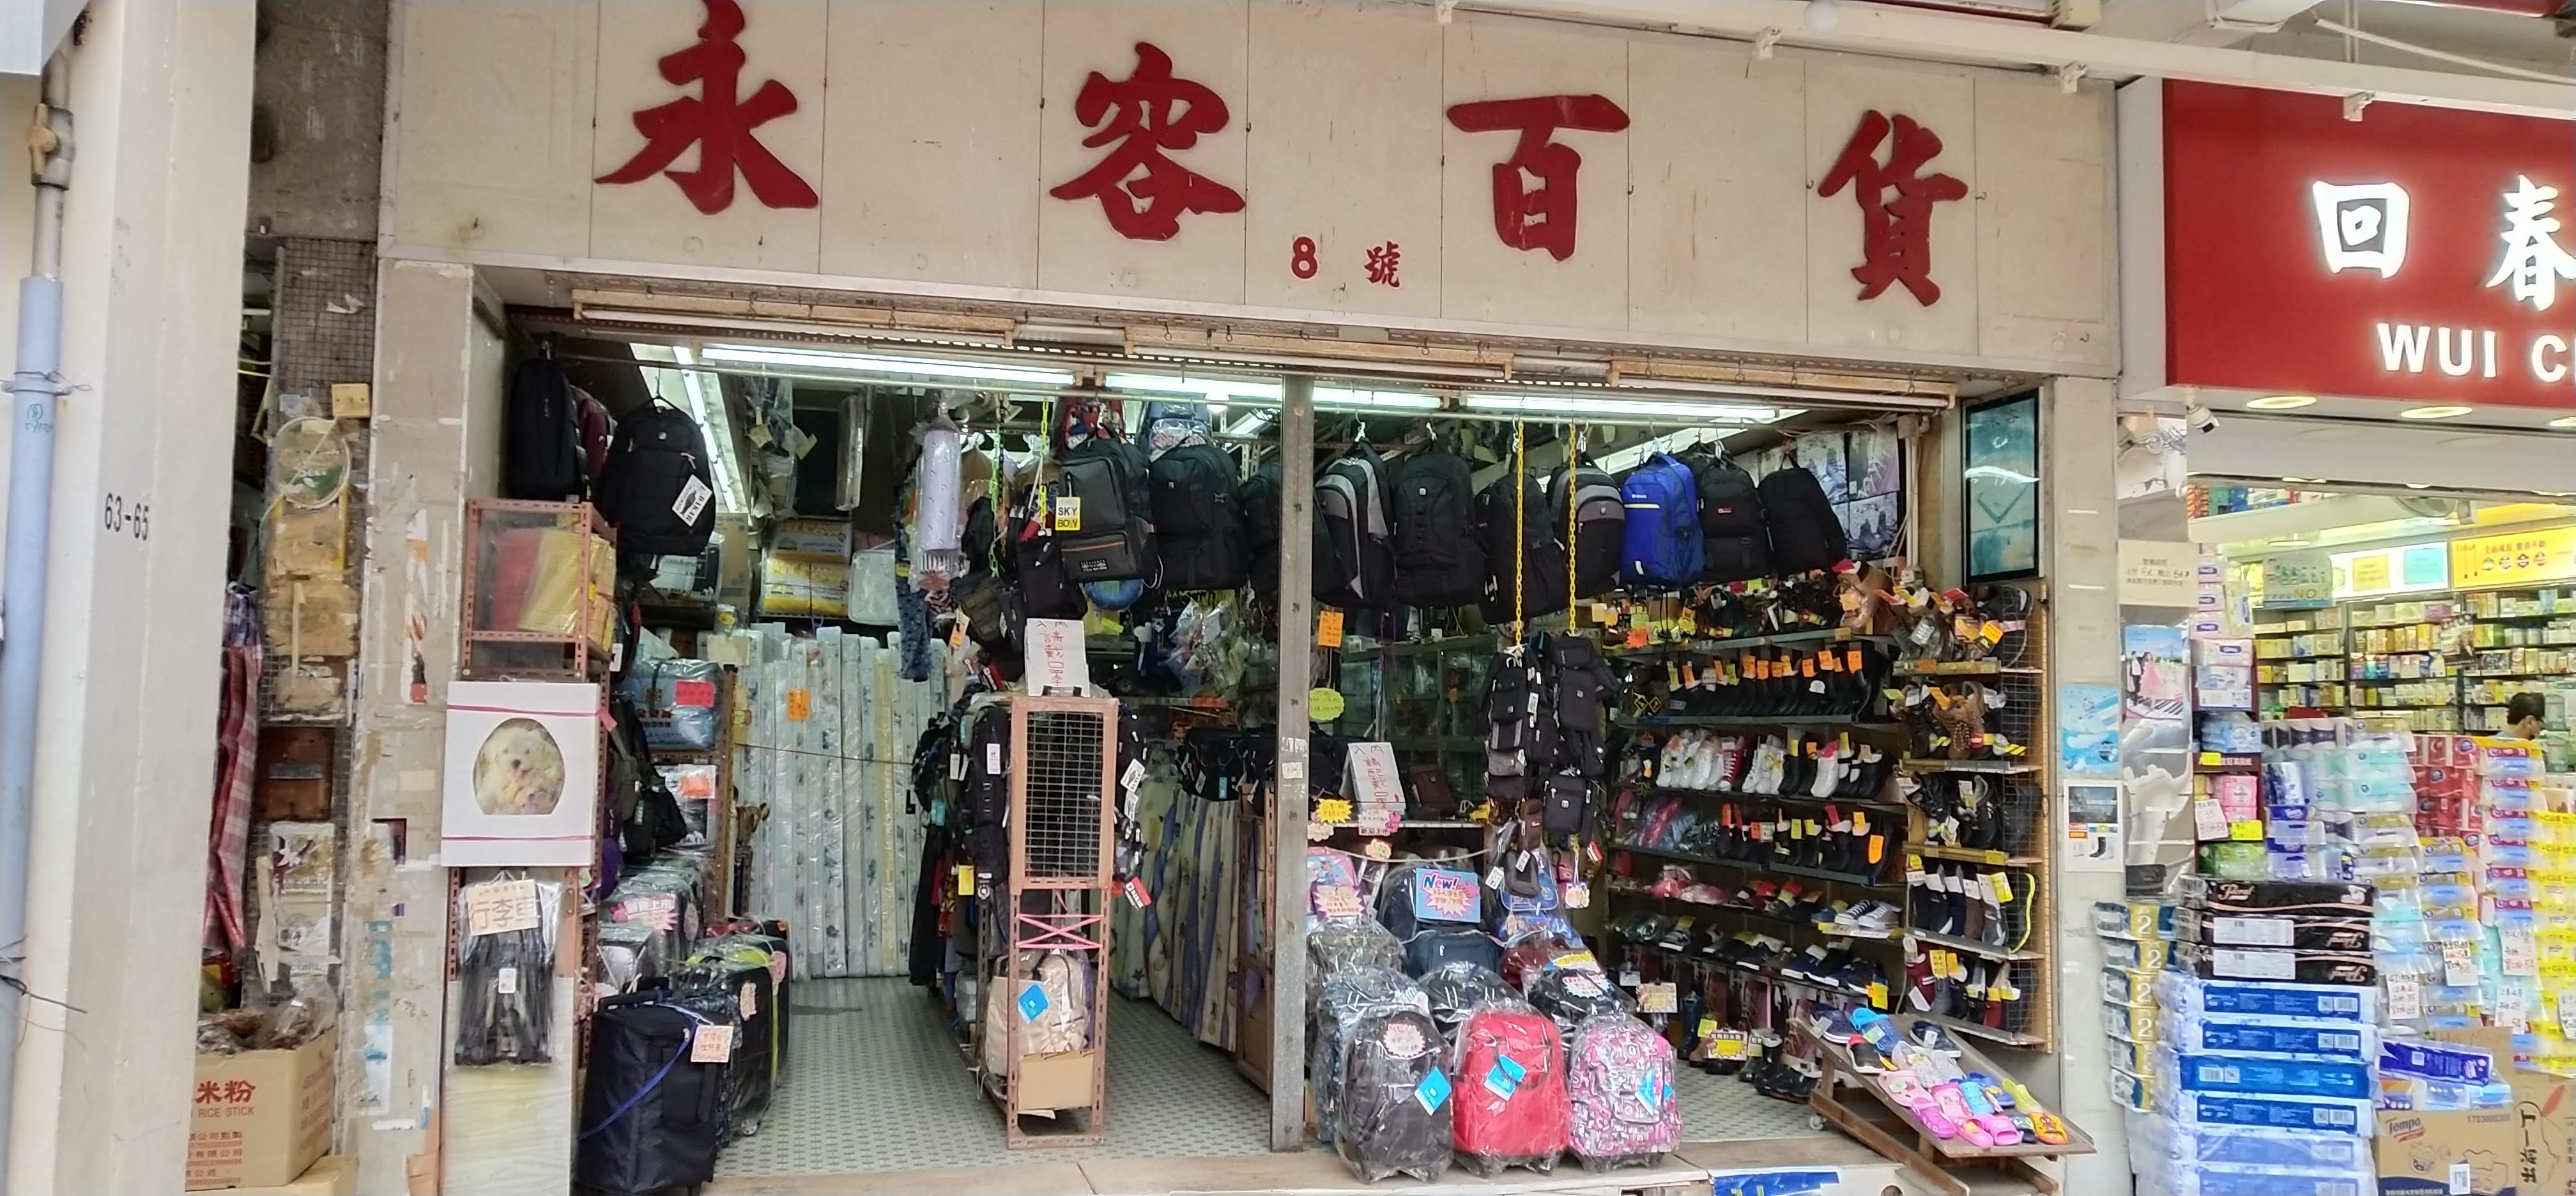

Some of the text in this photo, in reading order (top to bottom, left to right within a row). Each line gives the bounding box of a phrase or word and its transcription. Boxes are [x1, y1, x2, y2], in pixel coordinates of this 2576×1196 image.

[2377, 323, 2576, 382] WUI C
[103, 492, 150, 541] 63-65
[1057, 507, 1078, 516] SKY
[1057, 519, 1078, 528] BOW
[1423, 872, 1459, 890] New!
[2138, 916, 2152, 934] 2
[2147, 949, 2161, 969] 2
[2136, 983, 2151, 1002] 2
[2137, 1018, 2152, 1037] 2
[195, 1080, 256, 1105] 米粉
[198, 1106, 255, 1118] RICE STICK
[2386, 1117, 2421, 1134] Tempo
